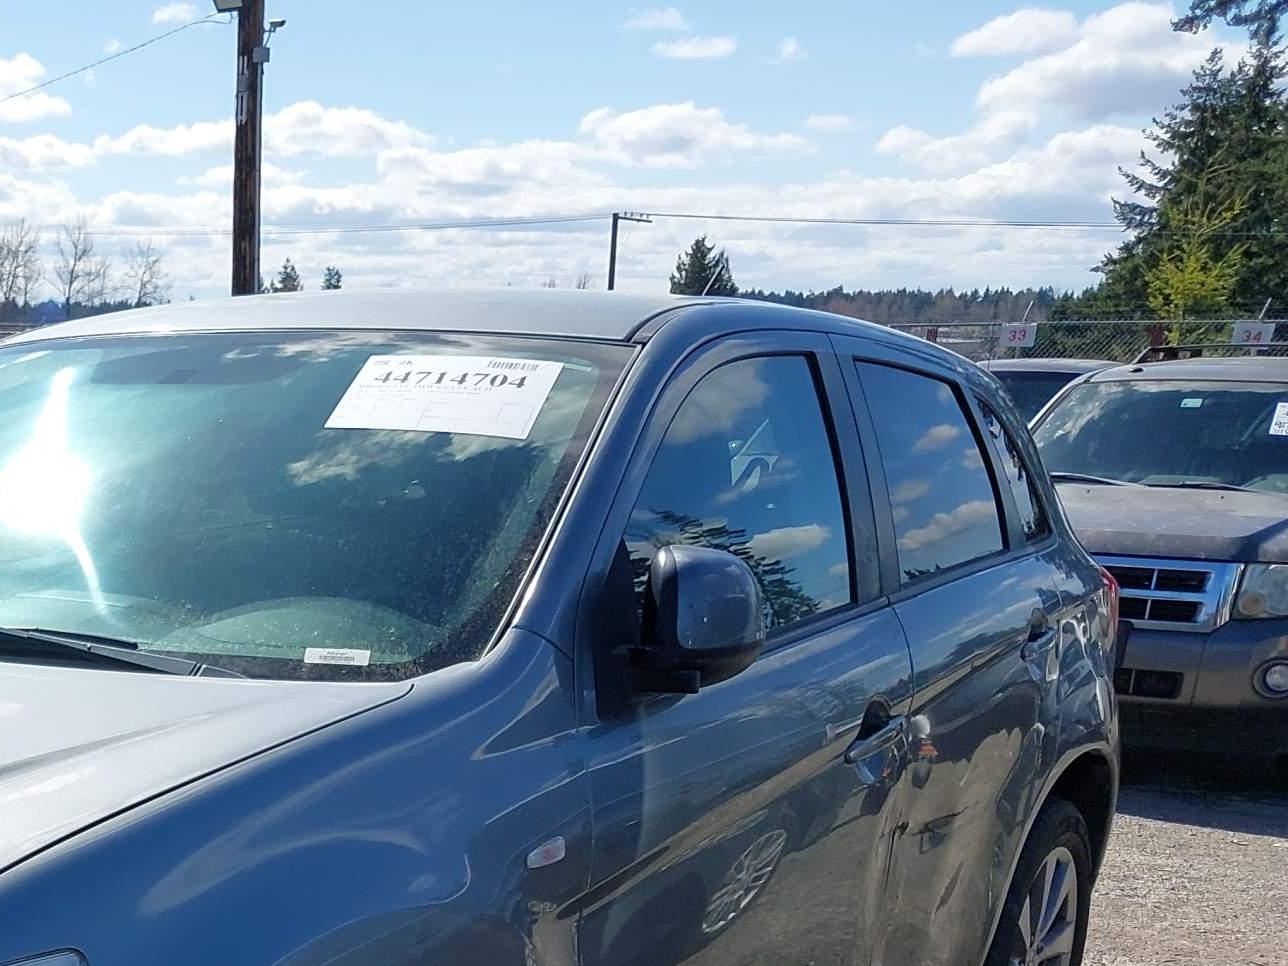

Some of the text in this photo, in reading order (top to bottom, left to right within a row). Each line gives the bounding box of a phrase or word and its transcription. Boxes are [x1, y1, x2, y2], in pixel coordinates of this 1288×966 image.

[1008, 329, 1027, 342] 33
[1242, 329, 1263, 344] 34
[373, 370, 529, 389] 44714704
